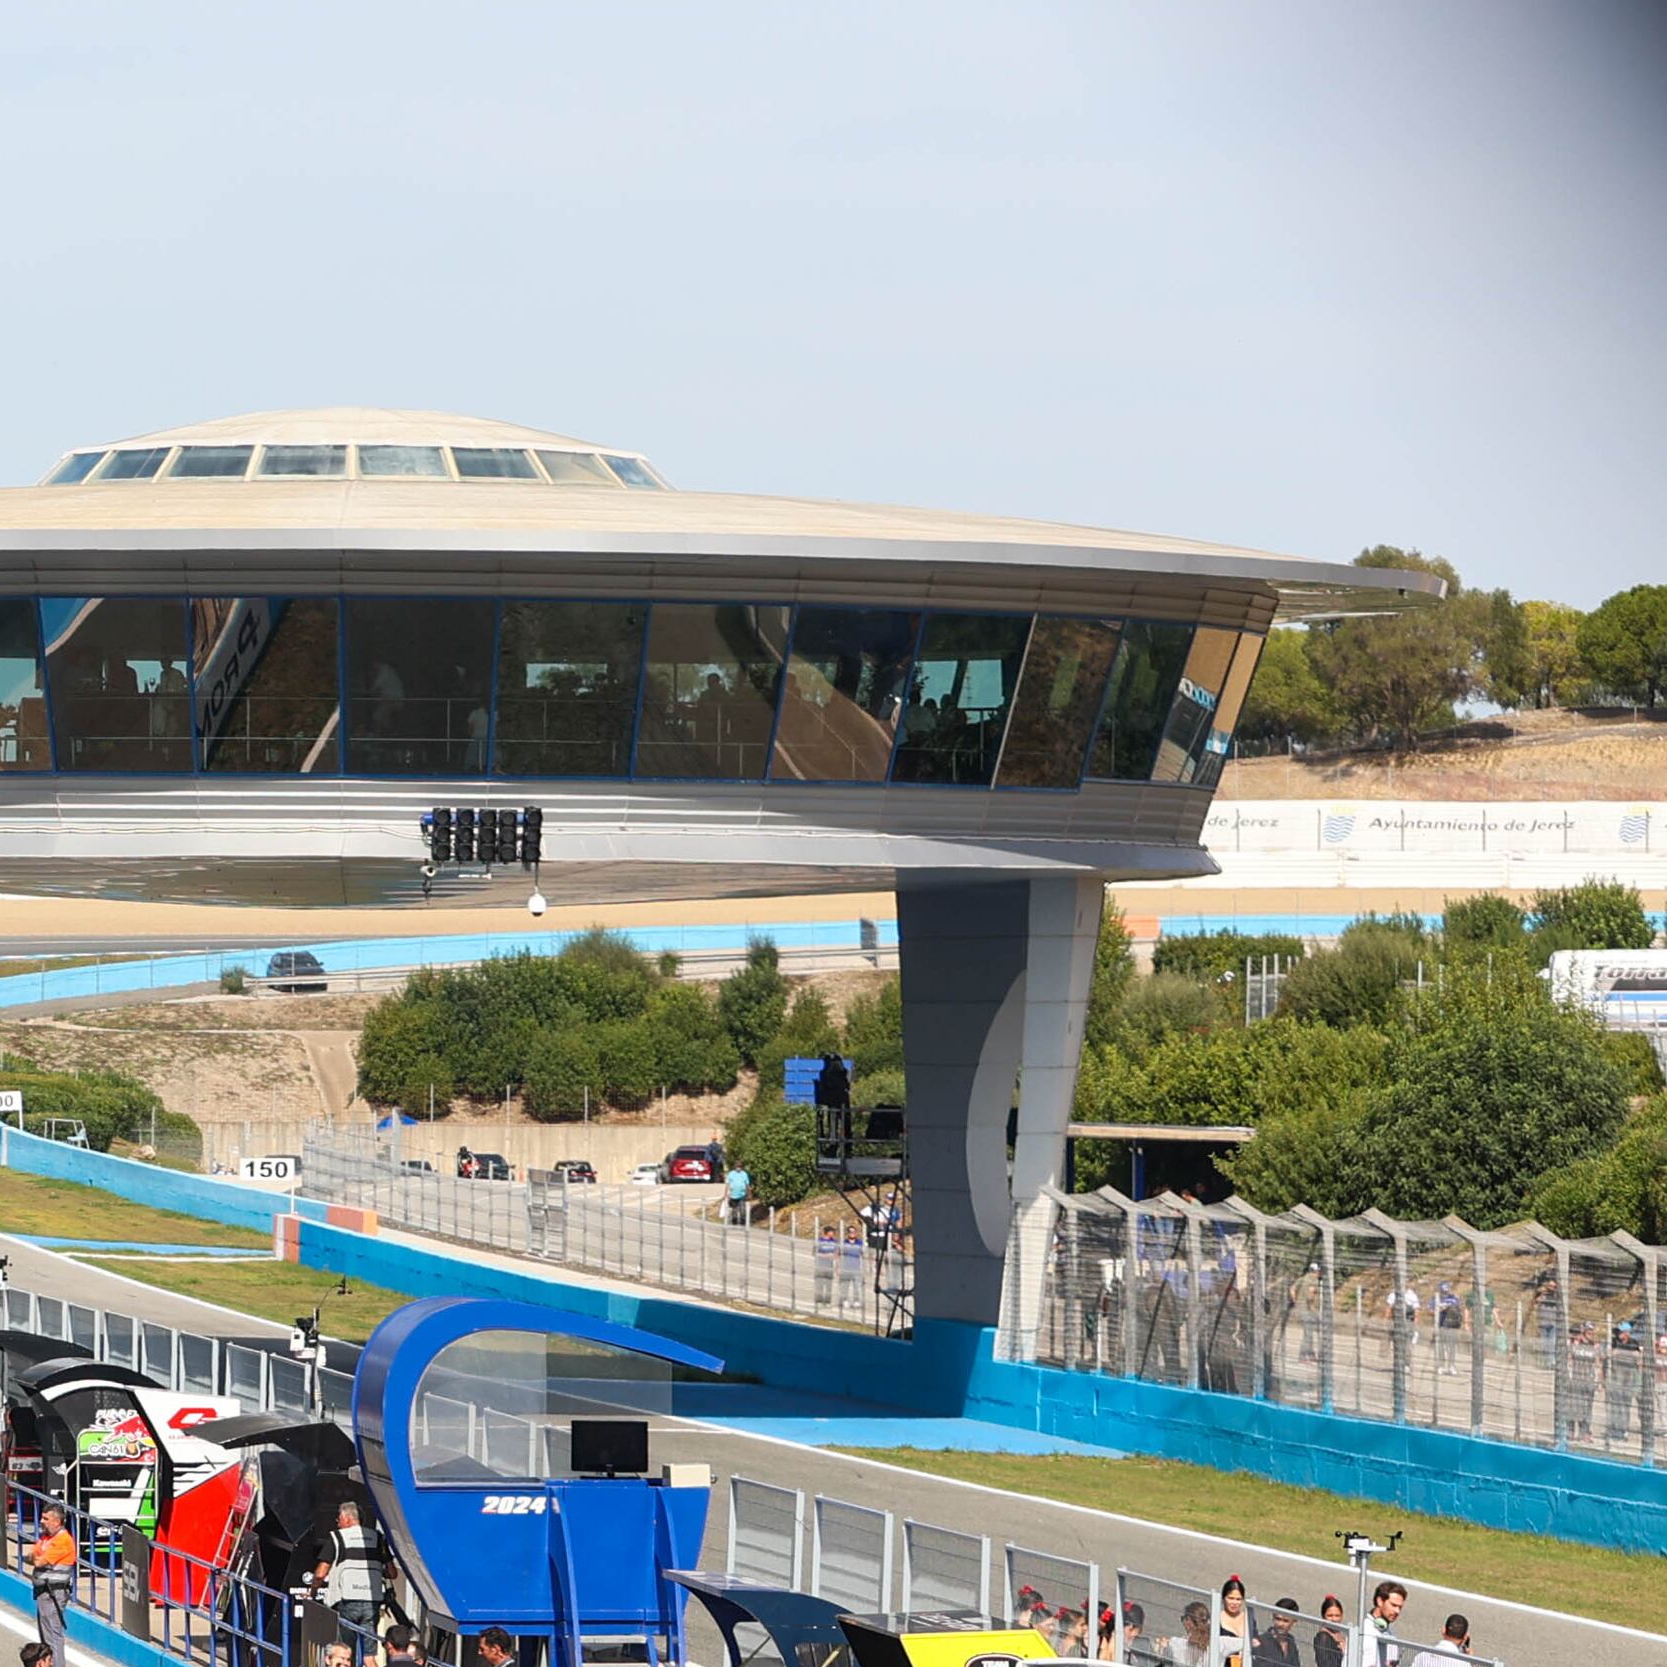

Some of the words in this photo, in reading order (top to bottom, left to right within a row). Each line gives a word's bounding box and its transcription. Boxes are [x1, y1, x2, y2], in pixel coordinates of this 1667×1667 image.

[1207, 816, 1228, 828] de
[1232, 815, 1279, 830] Jerez
[1369, 817, 1498, 832] Ayuntamiento
[1505, 818, 1526, 831] de
[1530, 819, 1575, 833] Jerez
[245, 1161, 288, 1179] 150
[482, 1496, 548, 1514] 2024
